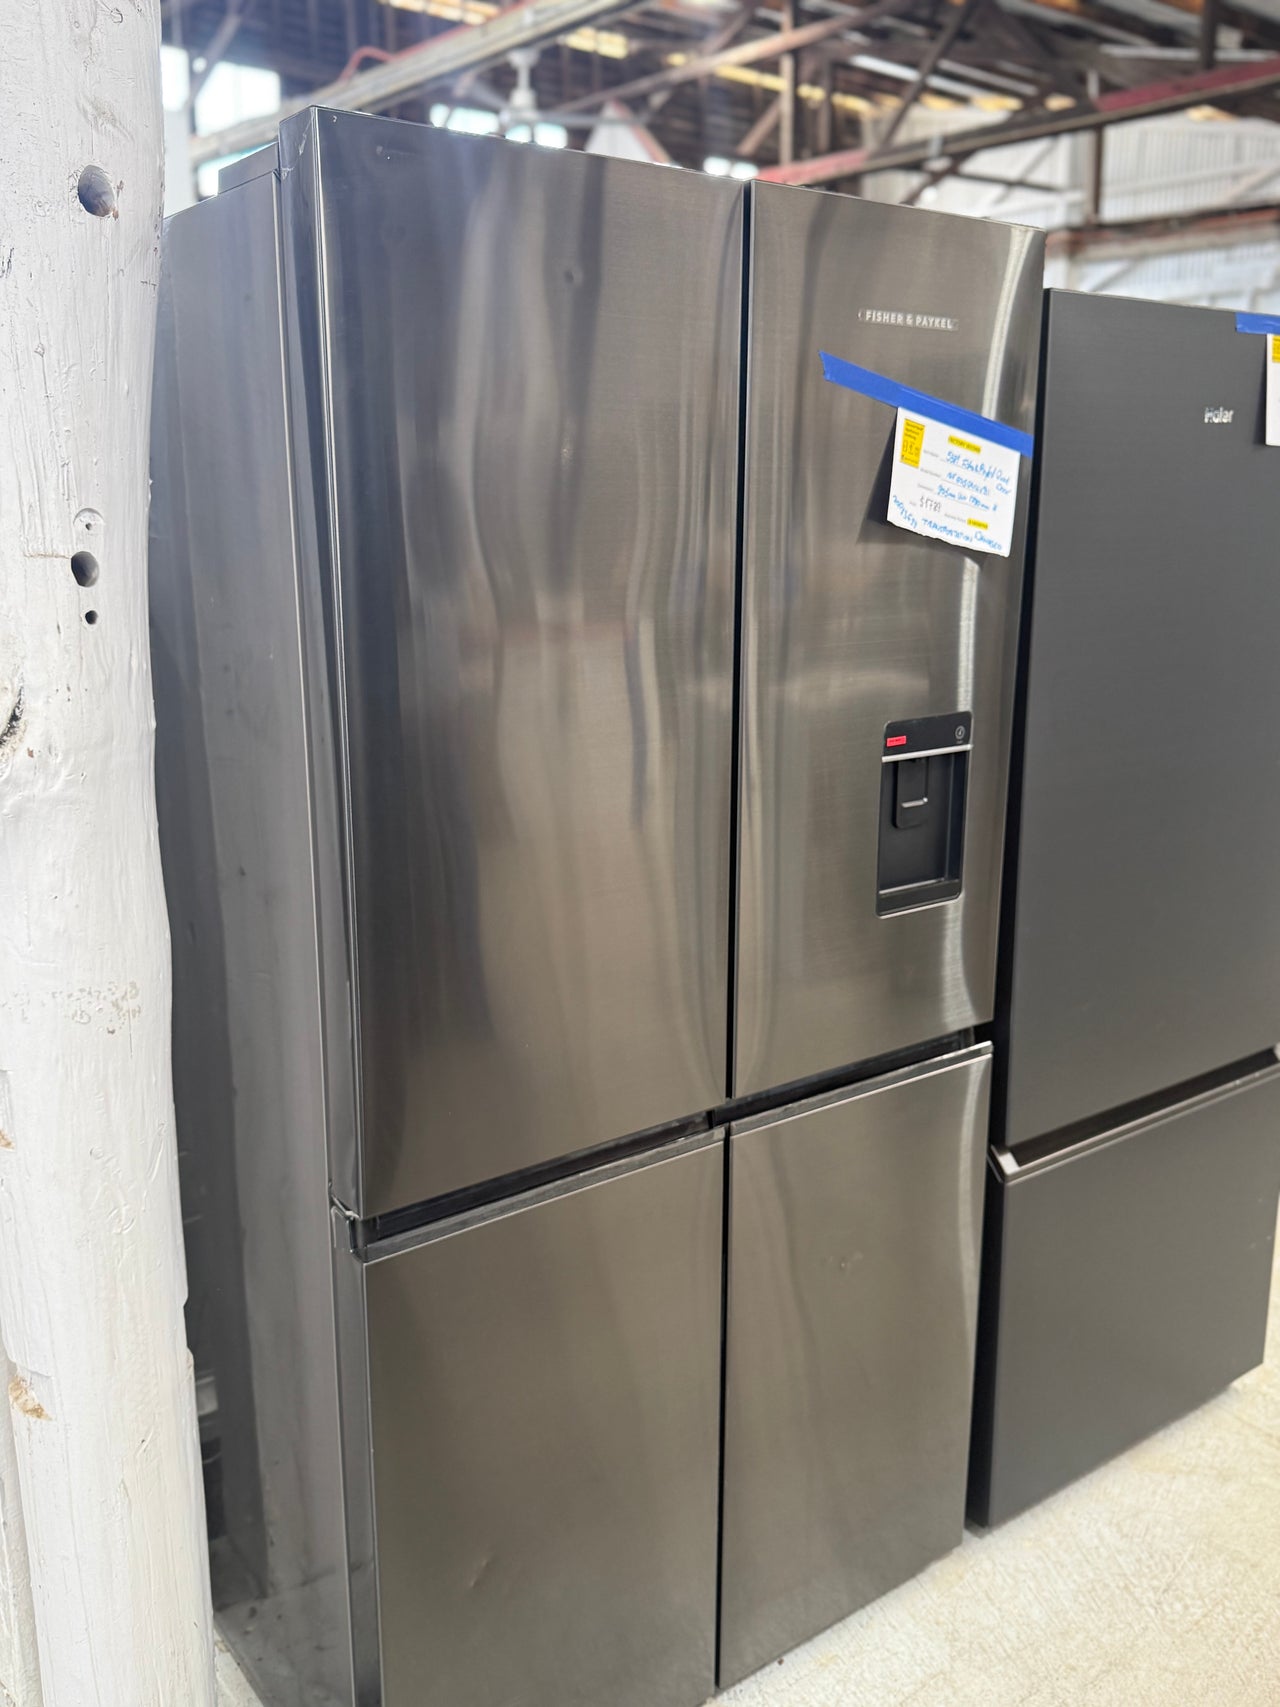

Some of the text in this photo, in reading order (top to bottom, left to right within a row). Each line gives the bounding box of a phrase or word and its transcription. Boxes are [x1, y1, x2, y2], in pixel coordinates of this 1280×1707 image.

[865, 309, 954, 330] FISHER & PAYKEL
